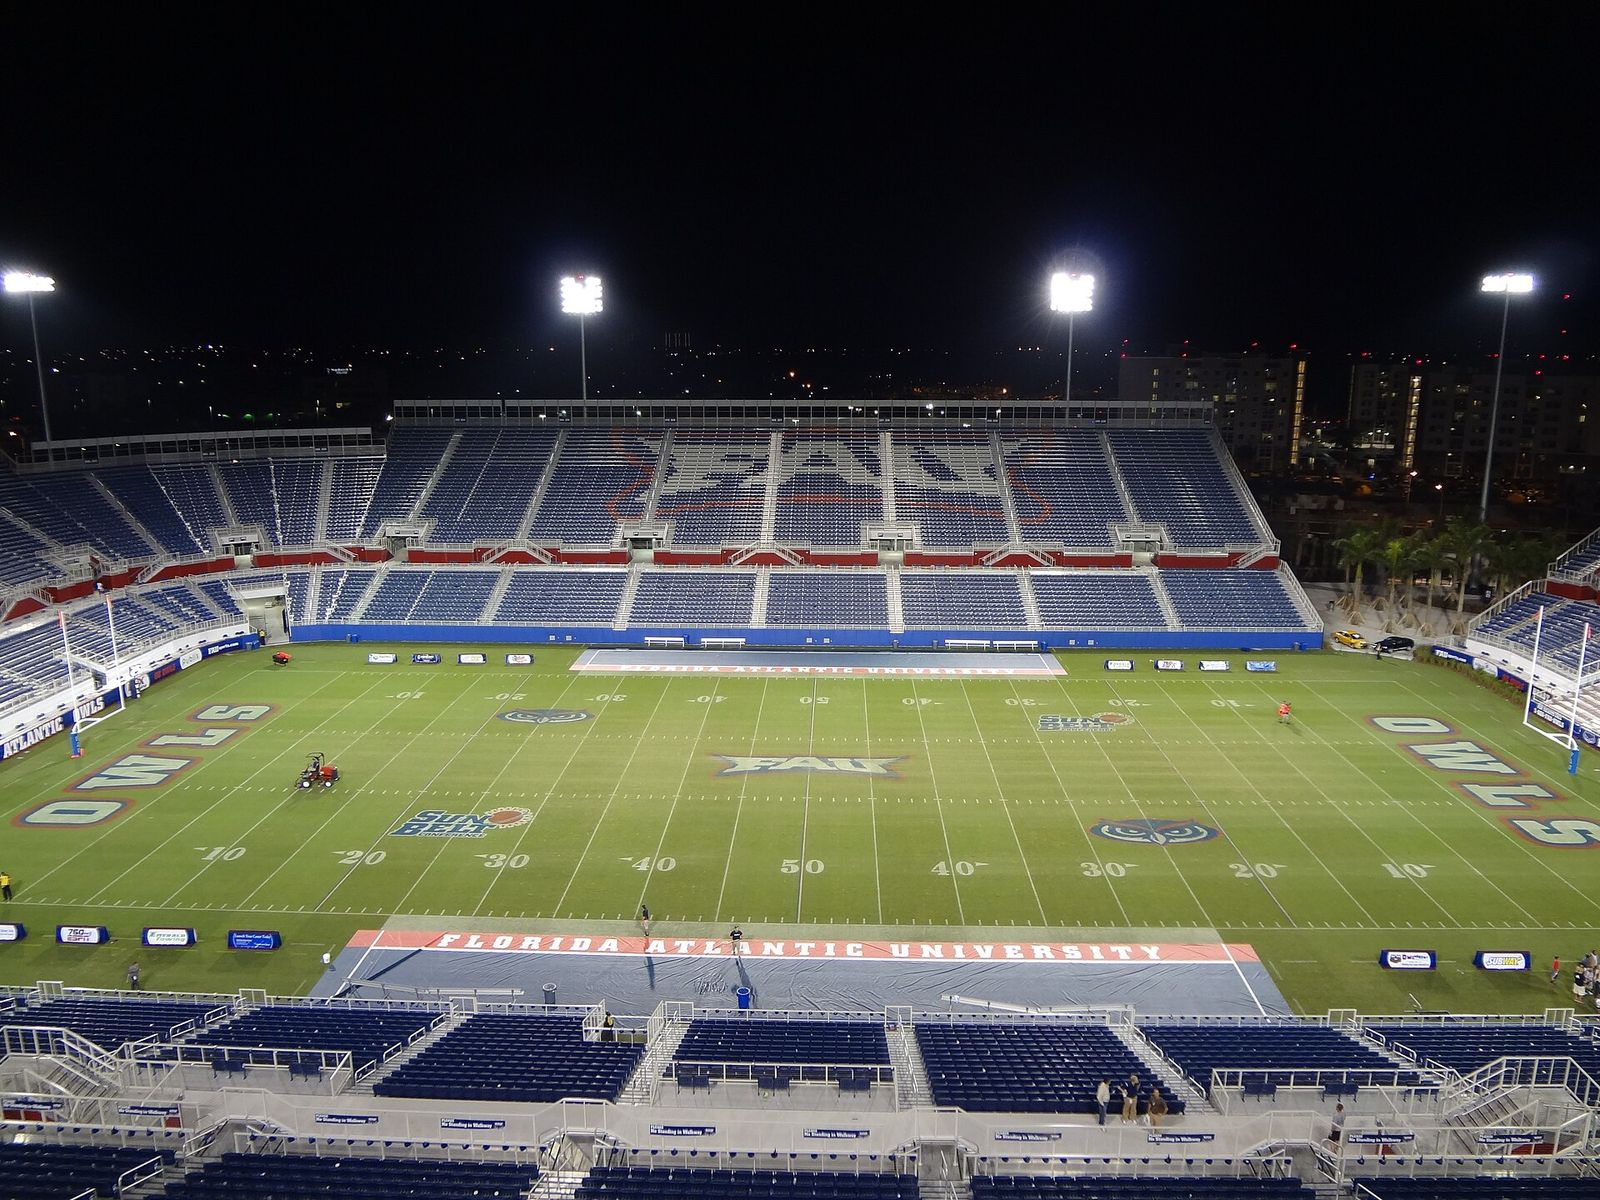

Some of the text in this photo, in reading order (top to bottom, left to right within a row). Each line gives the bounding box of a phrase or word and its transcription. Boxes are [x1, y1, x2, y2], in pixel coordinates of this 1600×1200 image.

[636, 438, 1027, 500] FAU
[596, 694, 628, 702] 30
[696, 696, 729, 704] 40
[799, 696, 830, 705] 50
[1108, 699, 1141, 707] 20
[1210, 700, 1241, 708] 10
[2, 716, 64, 760] ATLANTIC
[20, 704, 274, 826] OWLS
[712, 754, 908, 779] FAU
[1369, 715, 1600, 845] OWLS
[408, 810, 491, 824] SUN
[387, 822, 497, 837] BELT
[201, 846, 246, 861] 10
[338, 850, 387, 865] 20
[484, 854, 530, 868] 30
[631, 856, 677, 872] 40
[780, 859, 825, 874] 50
[930, 861, 975, 876] 40
[1080, 862, 1126, 877] 30
[1228, 863, 1278, 878] 20
[1382, 863, 1429, 878] 10
[436, 934, 1164, 960] FLORIDA ATLANTIC UNIVERSITY
[1486, 956, 1522, 966] SUBWAY
